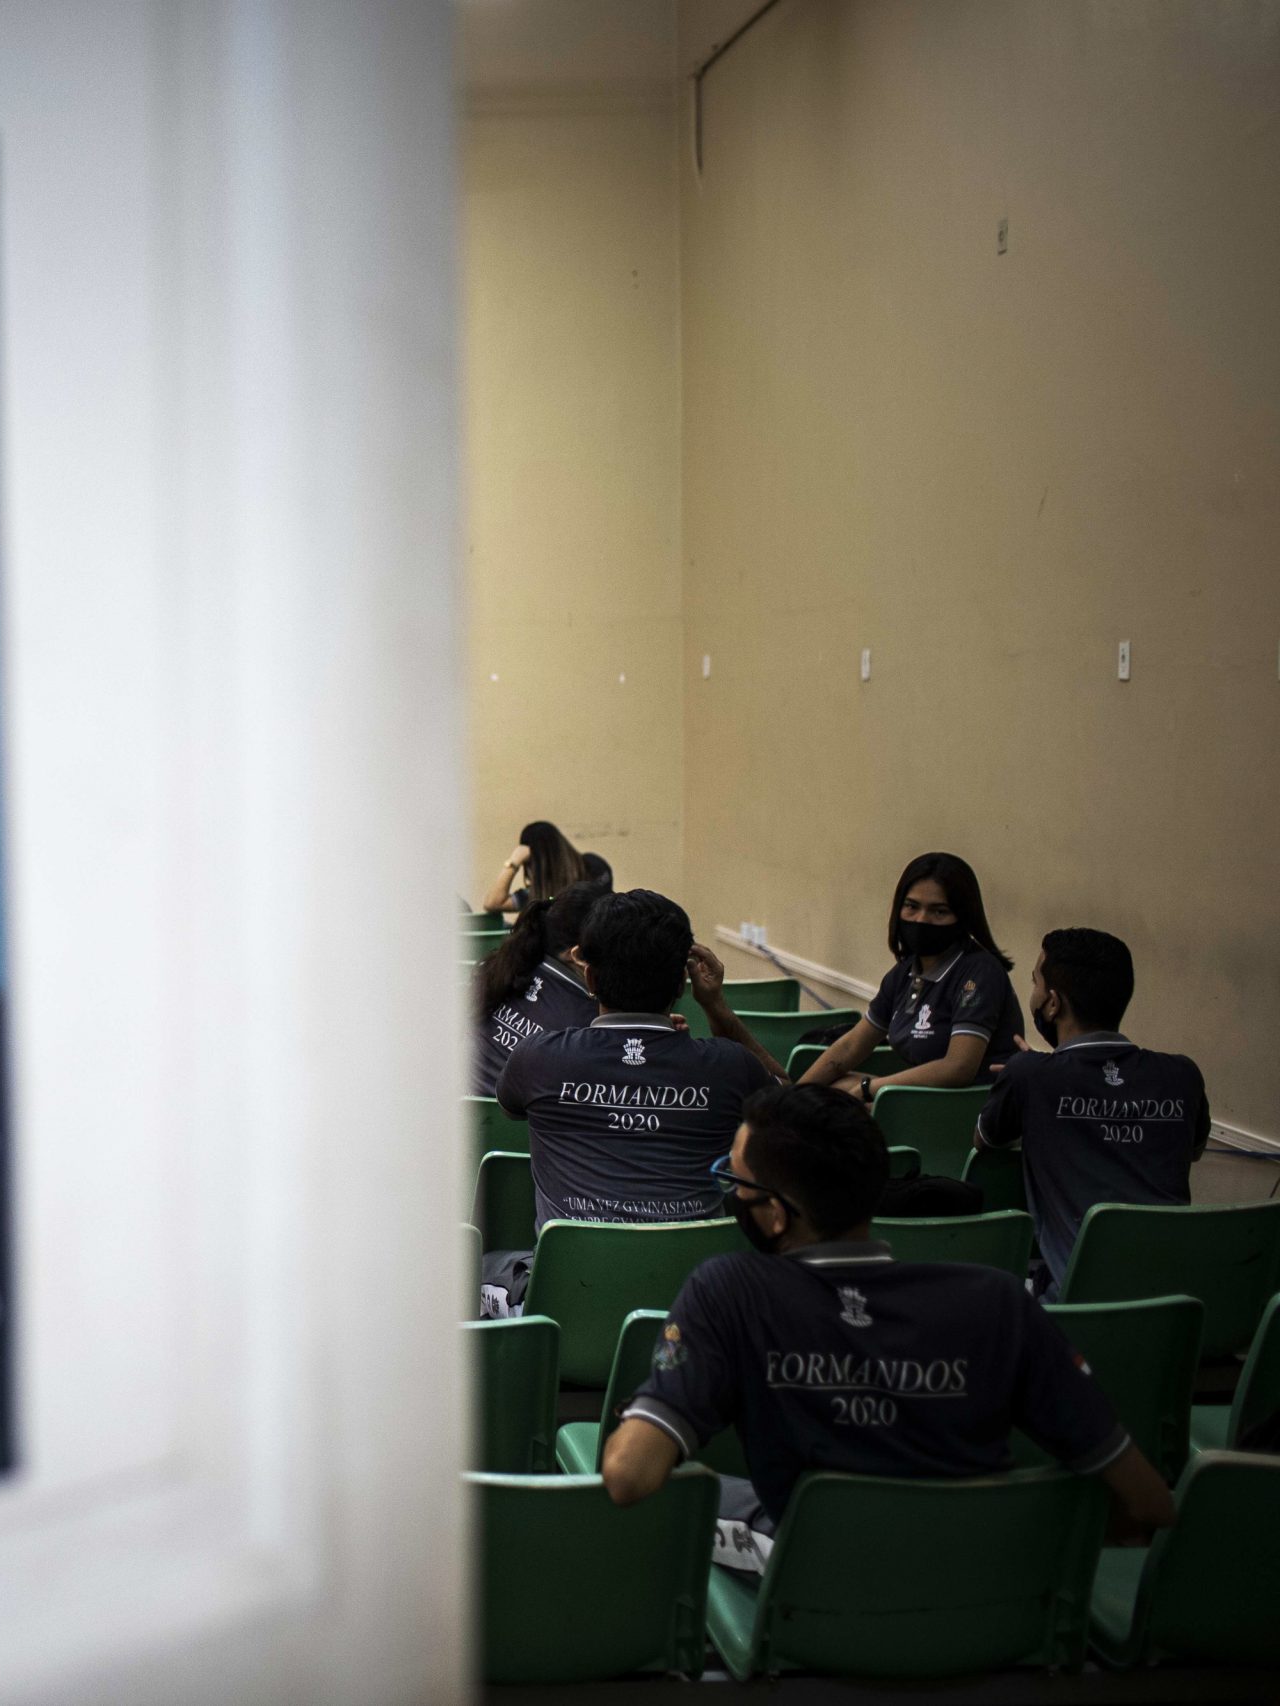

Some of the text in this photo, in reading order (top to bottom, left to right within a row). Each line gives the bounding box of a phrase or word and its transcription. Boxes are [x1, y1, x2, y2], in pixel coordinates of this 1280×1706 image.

[492, 1025, 518, 1051] 202
[559, 1082, 710, 1108] FORMANDOS
[1056, 1096, 1184, 1119] FORMANDOS
[608, 1112, 660, 1132] 2020
[1100, 1124, 1143, 1143] 2020
[597, 1198, 619, 1211] VEZ
[766, 1352, 968, 1393] FORMANDOS
[831, 1396, 897, 1426] 2020
